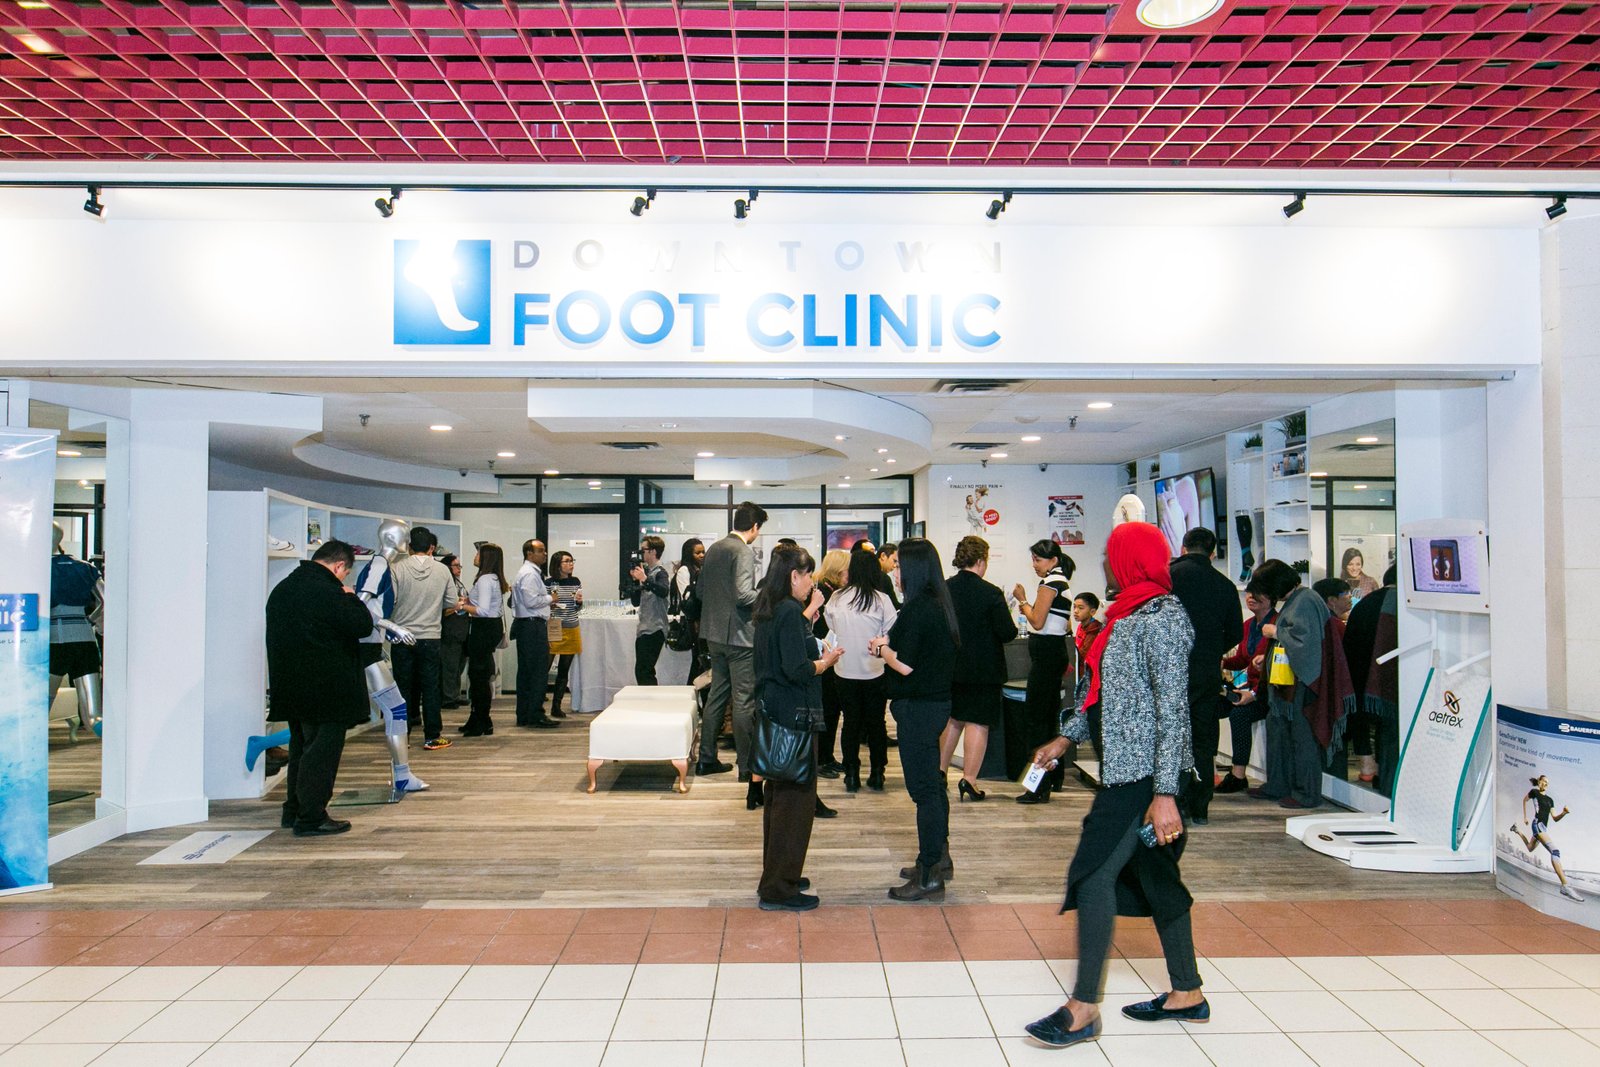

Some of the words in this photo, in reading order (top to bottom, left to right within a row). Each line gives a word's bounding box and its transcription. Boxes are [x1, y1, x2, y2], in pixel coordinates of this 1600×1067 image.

[513, 240, 1002, 271] DOWNTOWN
[513, 290, 720, 347] FOOT
[746, 290, 1002, 348] CLINIC
[1570, 726, 1600, 735] BAUERFEI
[1539, 751, 1545, 759] of
[1546, 753, 1583, 765] movement.
